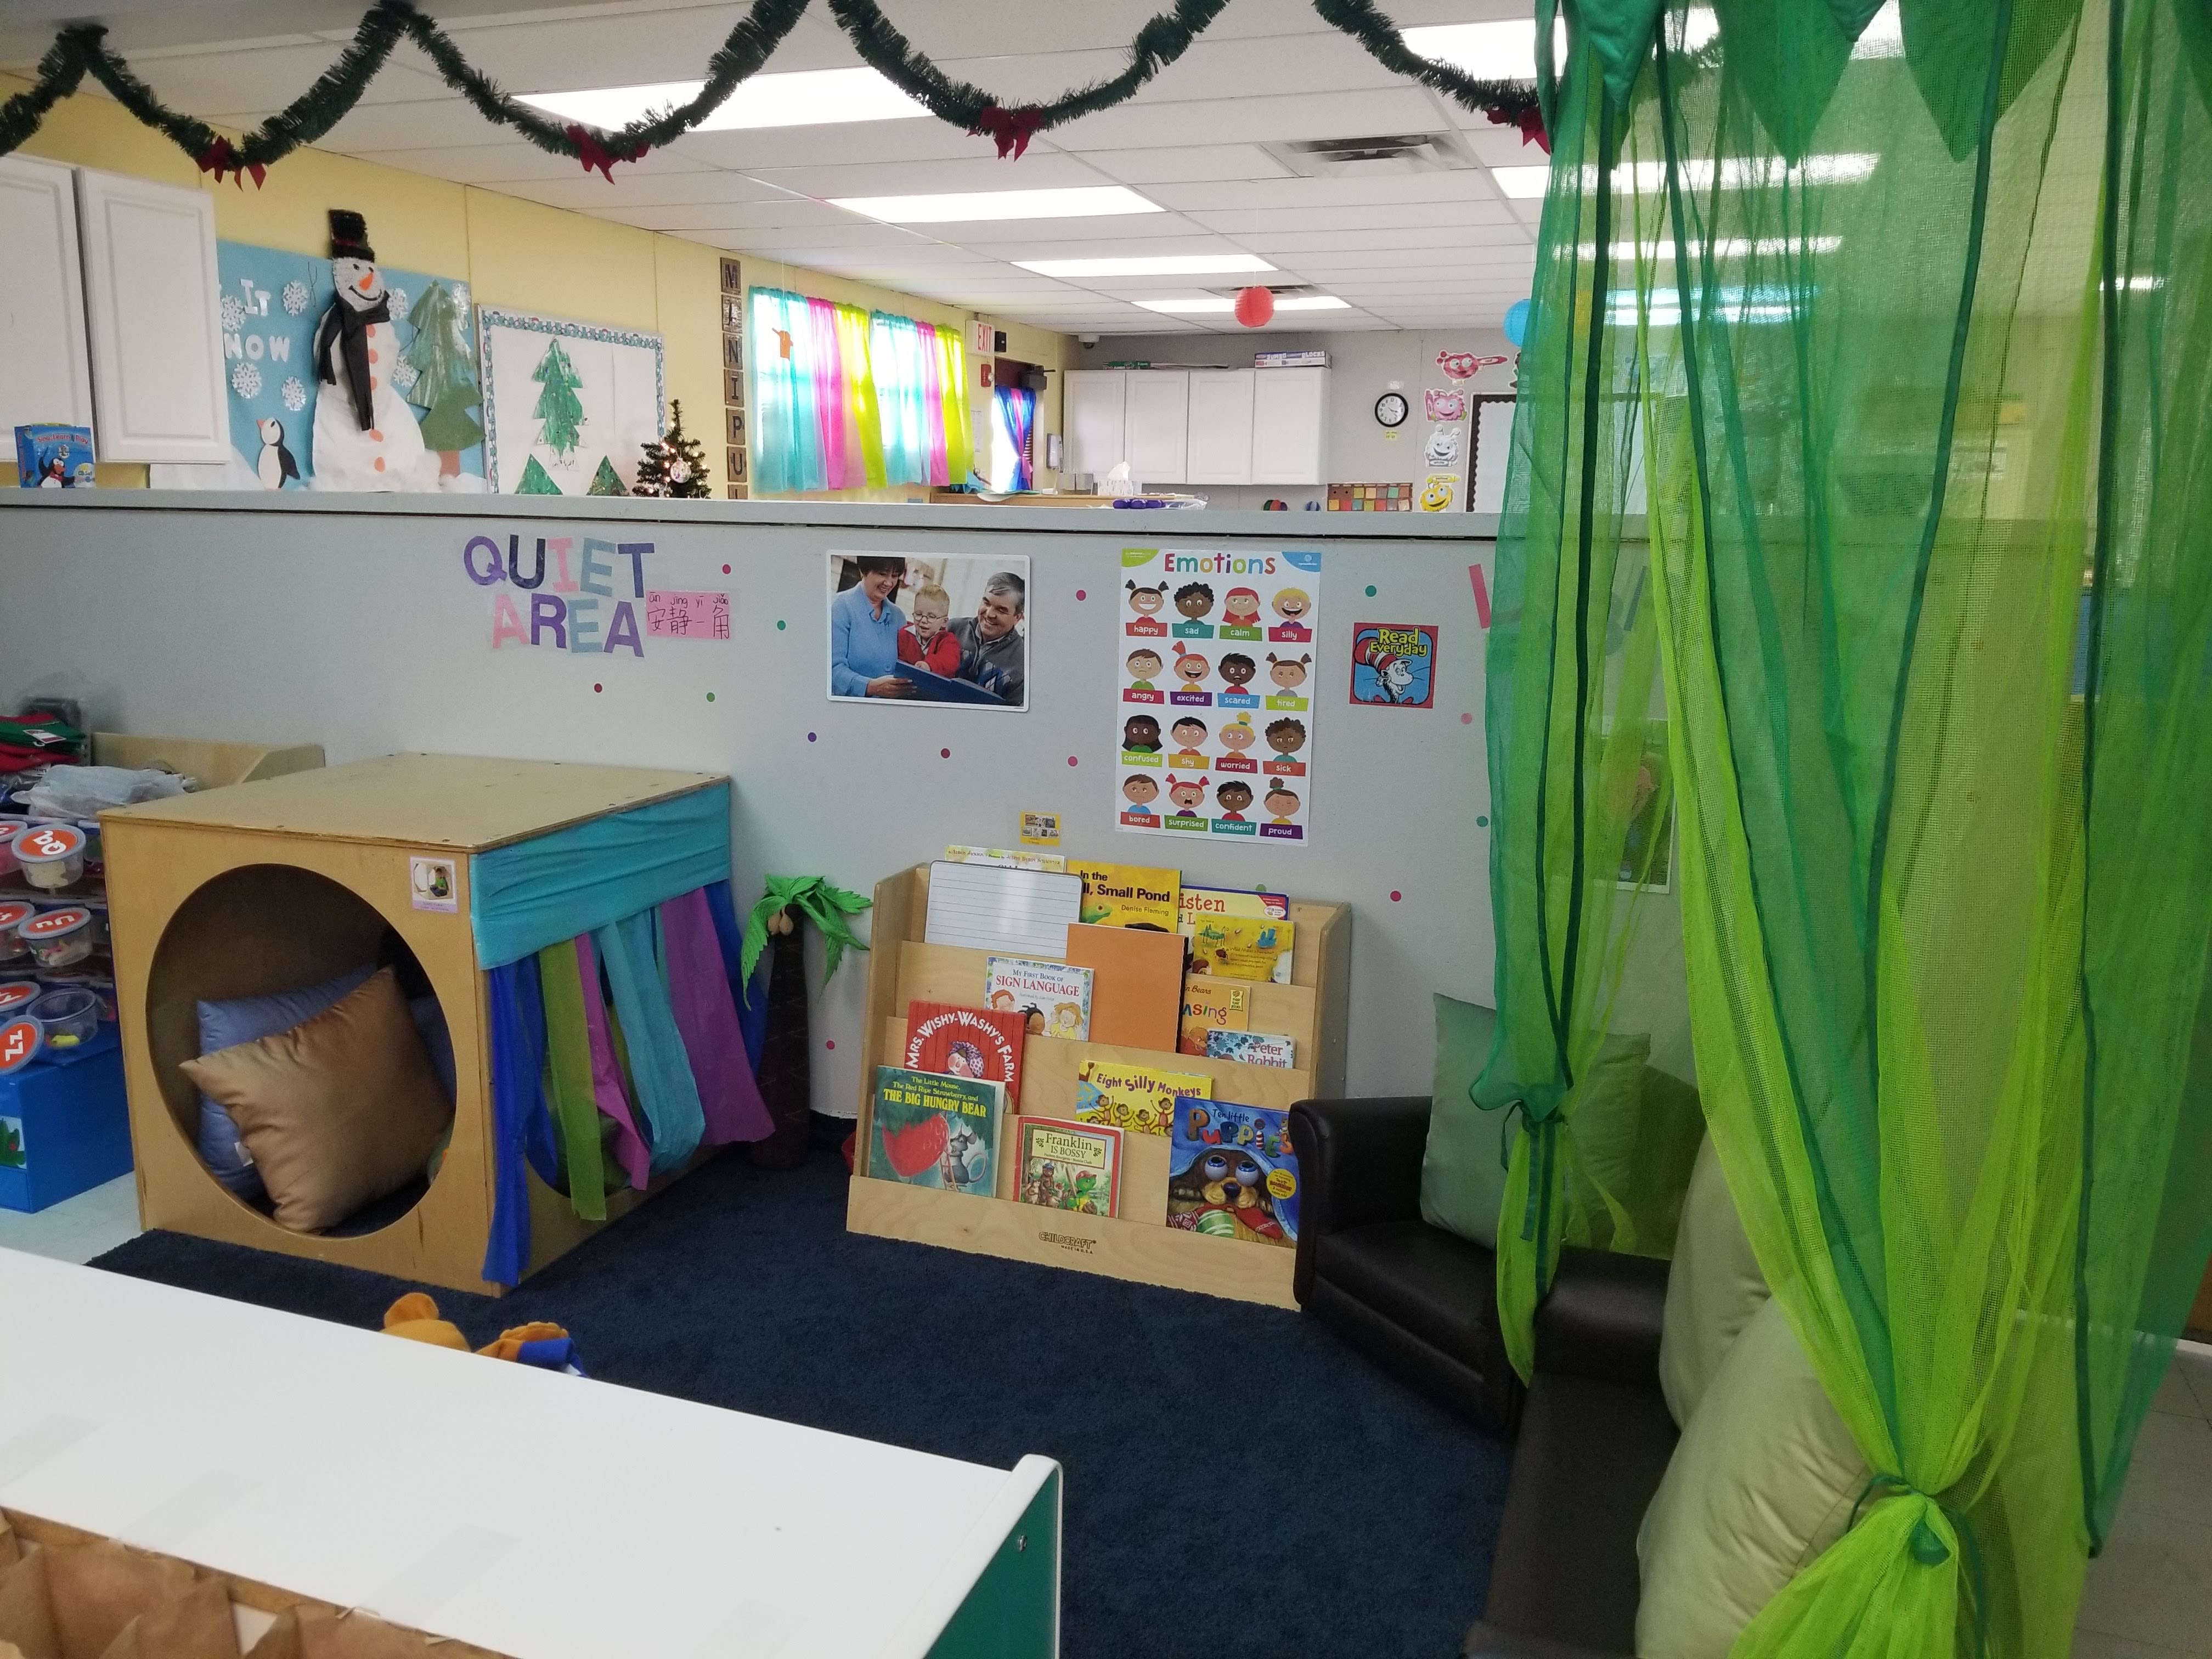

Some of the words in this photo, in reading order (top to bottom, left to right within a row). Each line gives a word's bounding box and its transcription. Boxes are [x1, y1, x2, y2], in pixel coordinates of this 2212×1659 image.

[978, 324, 992, 352] EXIT
[224, 333, 290, 363] NOW
[464, 534, 655, 598] QUIET
[1165, 553, 1276, 574] Emotions
[493, 592, 644, 657] AREA
[1134, 625, 1159, 635] happy
[1282, 631, 1297, 640] silly
[1378, 628, 1419, 645] Read
[1370, 642, 1427, 657] Everyday
[1131, 693, 1154, 702] angry
[1124, 754, 1159, 763] confused
[1181, 758, 1194, 767] shy
[1169, 819, 1204, 828] surprised
[1215, 823, 1252, 832] confident
[1268, 826, 1293, 835] proud
[1081, 870, 1088, 879] In
[1092, 872, 1108, 881] the
[1097, 884, 1133, 899] Small
[1137, 888, 1170, 902] Pond
[1179, 893, 1225, 912] isten
[1144, 907, 1169, 916] Fleming
[996, 975, 1020, 988] SIGN
[1024, 979, 1080, 996] LANGUAGE
[1192, 985, 1211, 994] Bears
[1253, 1042, 1283, 1056] Peter
[997, 1045, 1015, 1082] FARM
[1248, 1054, 1287, 1068] Rabbit
[918, 1085, 931, 1094] Ripe
[933, 1088, 967, 1099] Strawberry,
[940, 1081, 961, 1090] Mouse,
[1097, 1073, 1122, 1088] Eight
[1125, 1075, 1155, 1093] Silly
[1157, 1082, 1201, 1097] Monkeys
[883, 1088, 901, 1103] THE
[905, 1092, 921, 1106] BIG
[923, 1095, 960, 1111] HUNGRY
[962, 1102, 986, 1118] BEAR
[1212, 1109, 1226, 1118] Ten
[1229, 1111, 1250, 1124] little
[1046, 1133, 1092, 1150] Franklin
[1060, 1147, 1086, 1159] BOSSY
[1039, 1232, 1092, 1249] CHILDCRAFT
